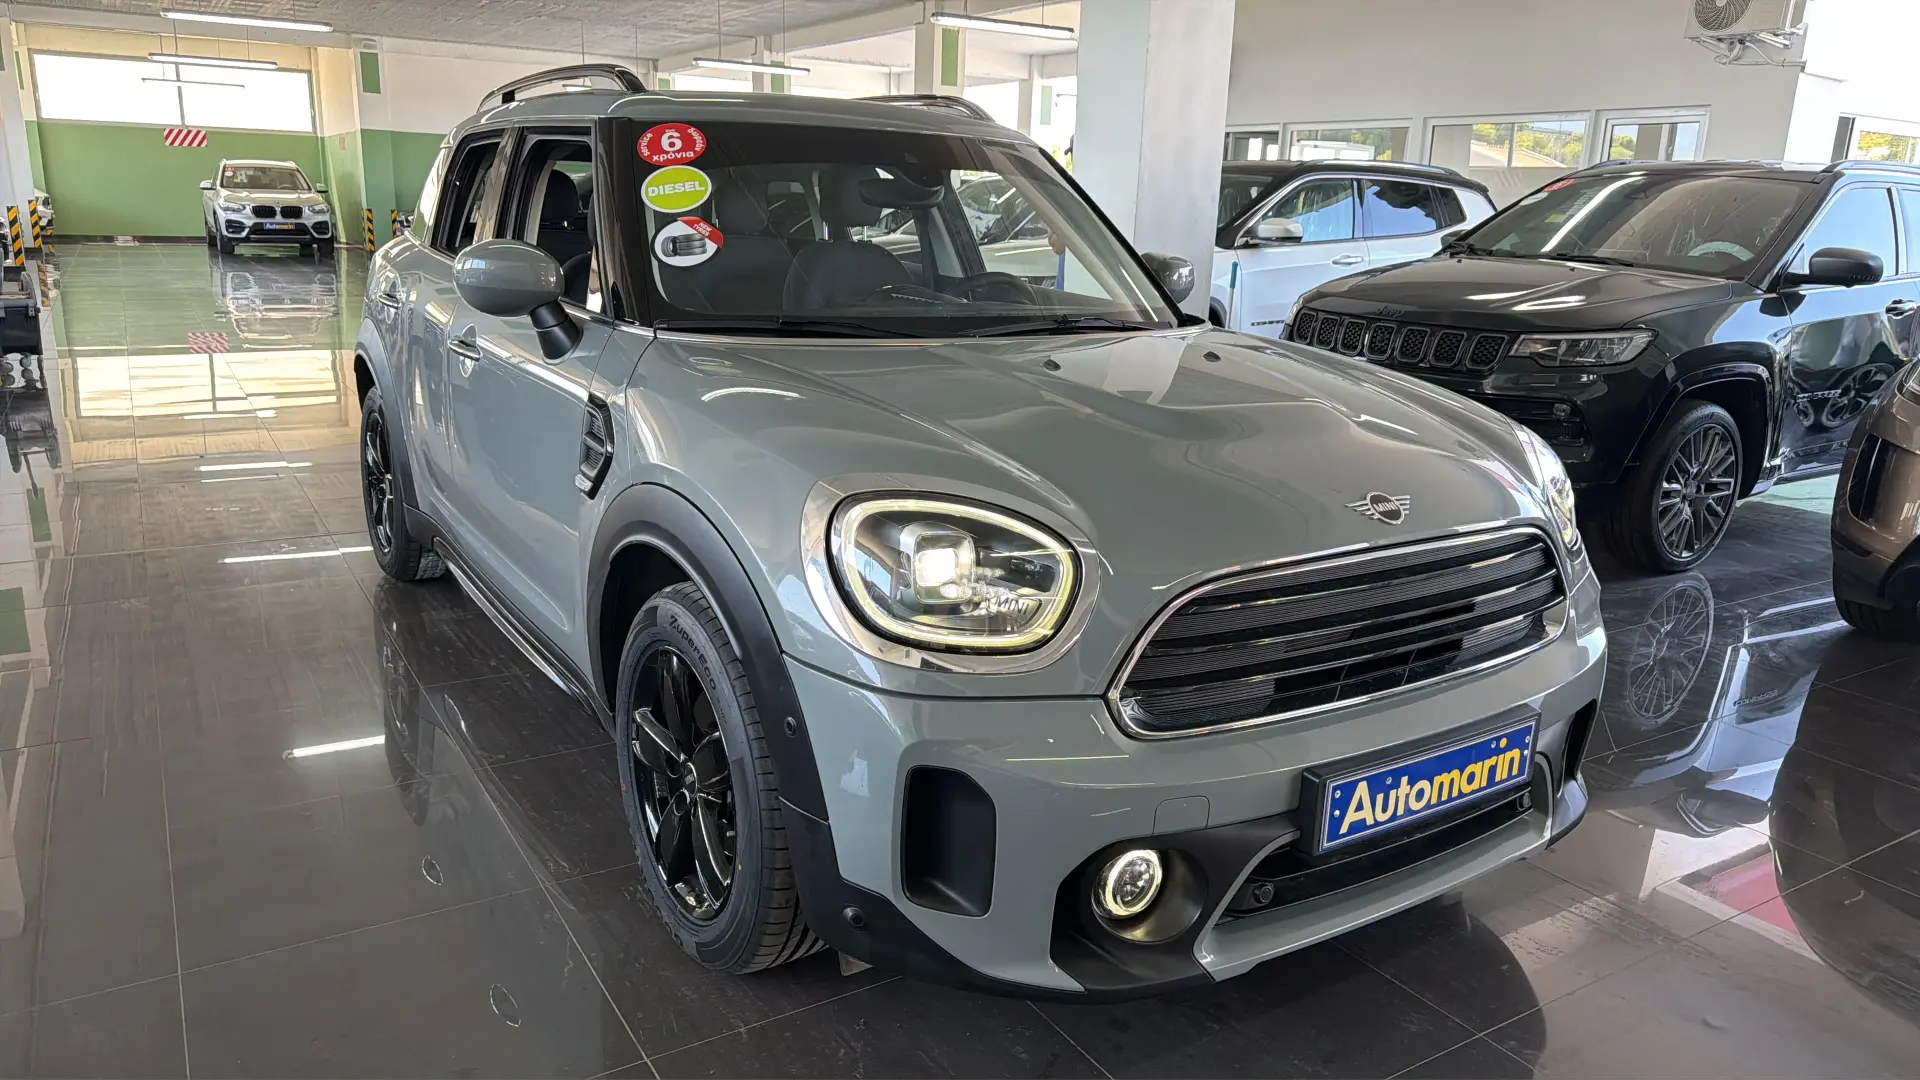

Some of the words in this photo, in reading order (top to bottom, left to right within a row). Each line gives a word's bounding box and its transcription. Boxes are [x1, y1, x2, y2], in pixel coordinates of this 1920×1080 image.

[640, 132, 653, 157] service
[661, 131, 683, 152] 6
[652, 151, 695, 162] χρόνια
[647, 181, 706, 197] DIESEL
[692, 223, 710, 237] TYRES
[698, 222, 713, 233] NEW
[1372, 501, 1399, 512] MINI
[993, 596, 1030, 616] MINI
[1338, 737, 1521, 835] Automarin
